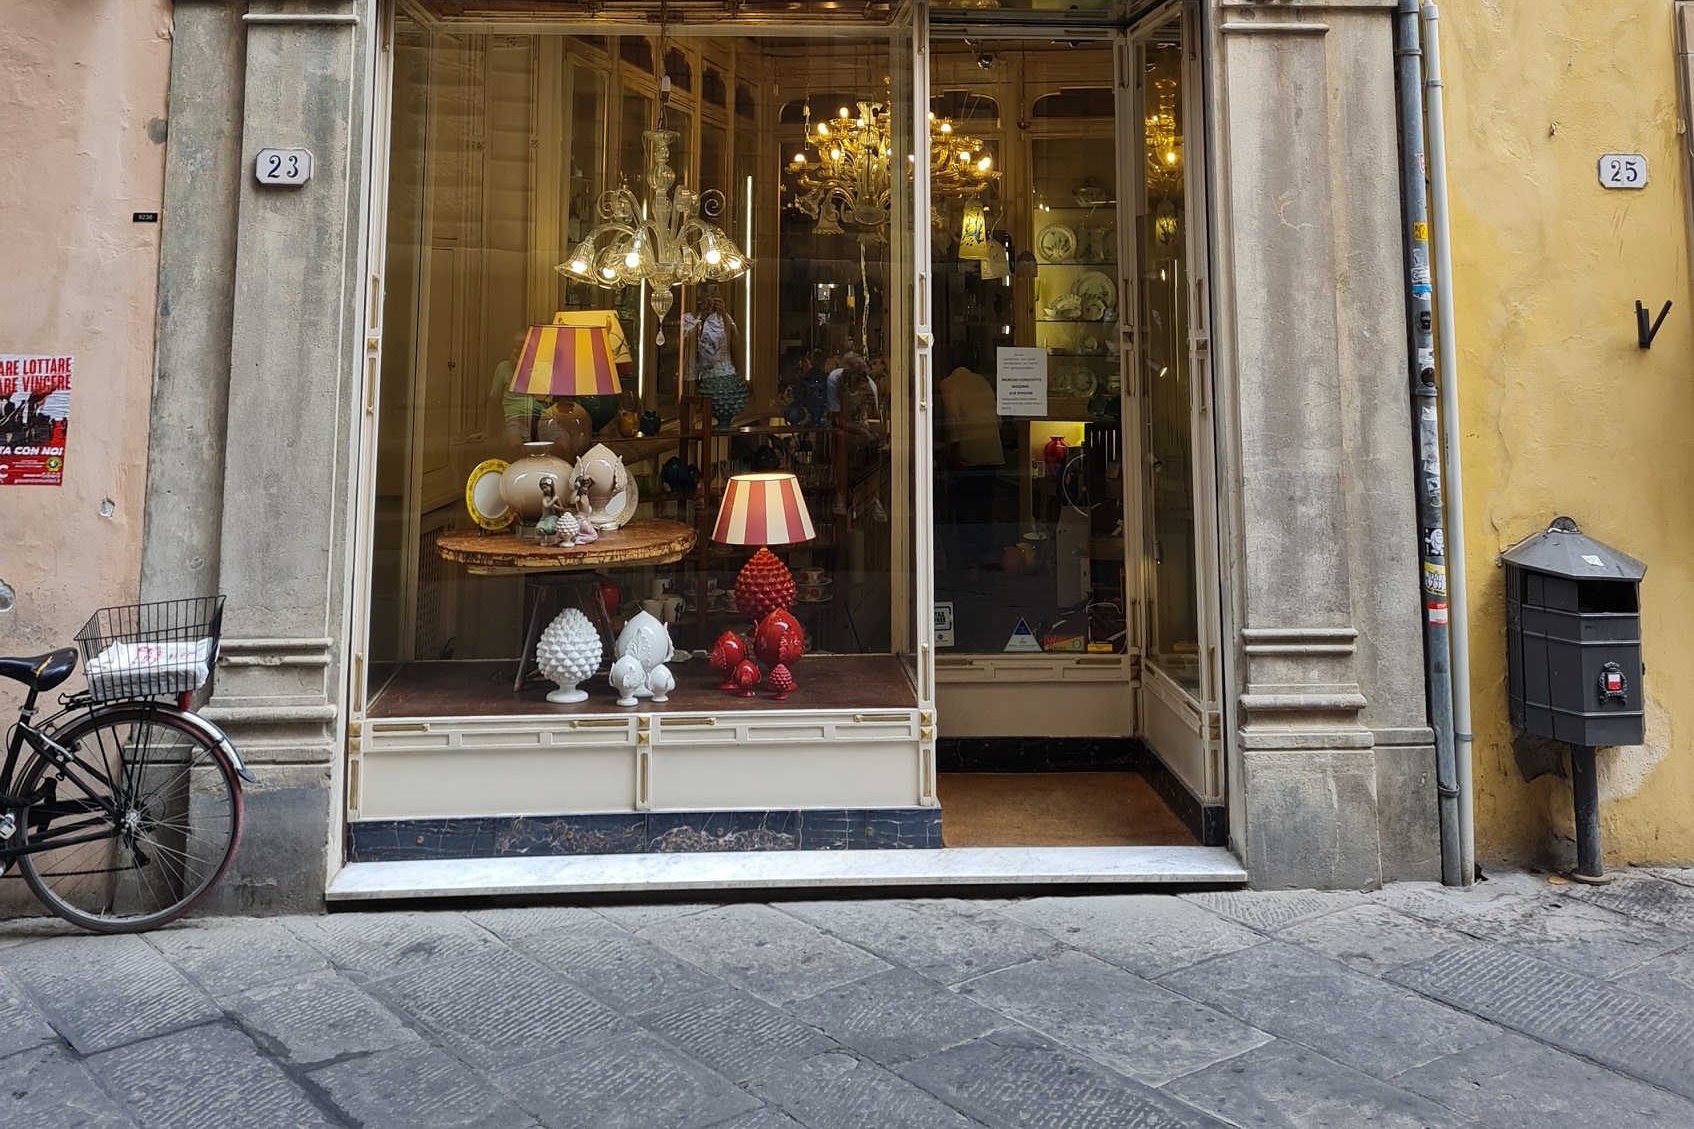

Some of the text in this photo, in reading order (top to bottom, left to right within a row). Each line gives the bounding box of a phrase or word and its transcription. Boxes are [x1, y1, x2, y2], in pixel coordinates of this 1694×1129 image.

[267, 154, 299, 179] 23
[1610, 159, 1638, 183] 25
[23, 357, 72, 375] LOTTARE
[22, 374, 72, 392] VINCERE
[14, 446, 40, 456] CON
